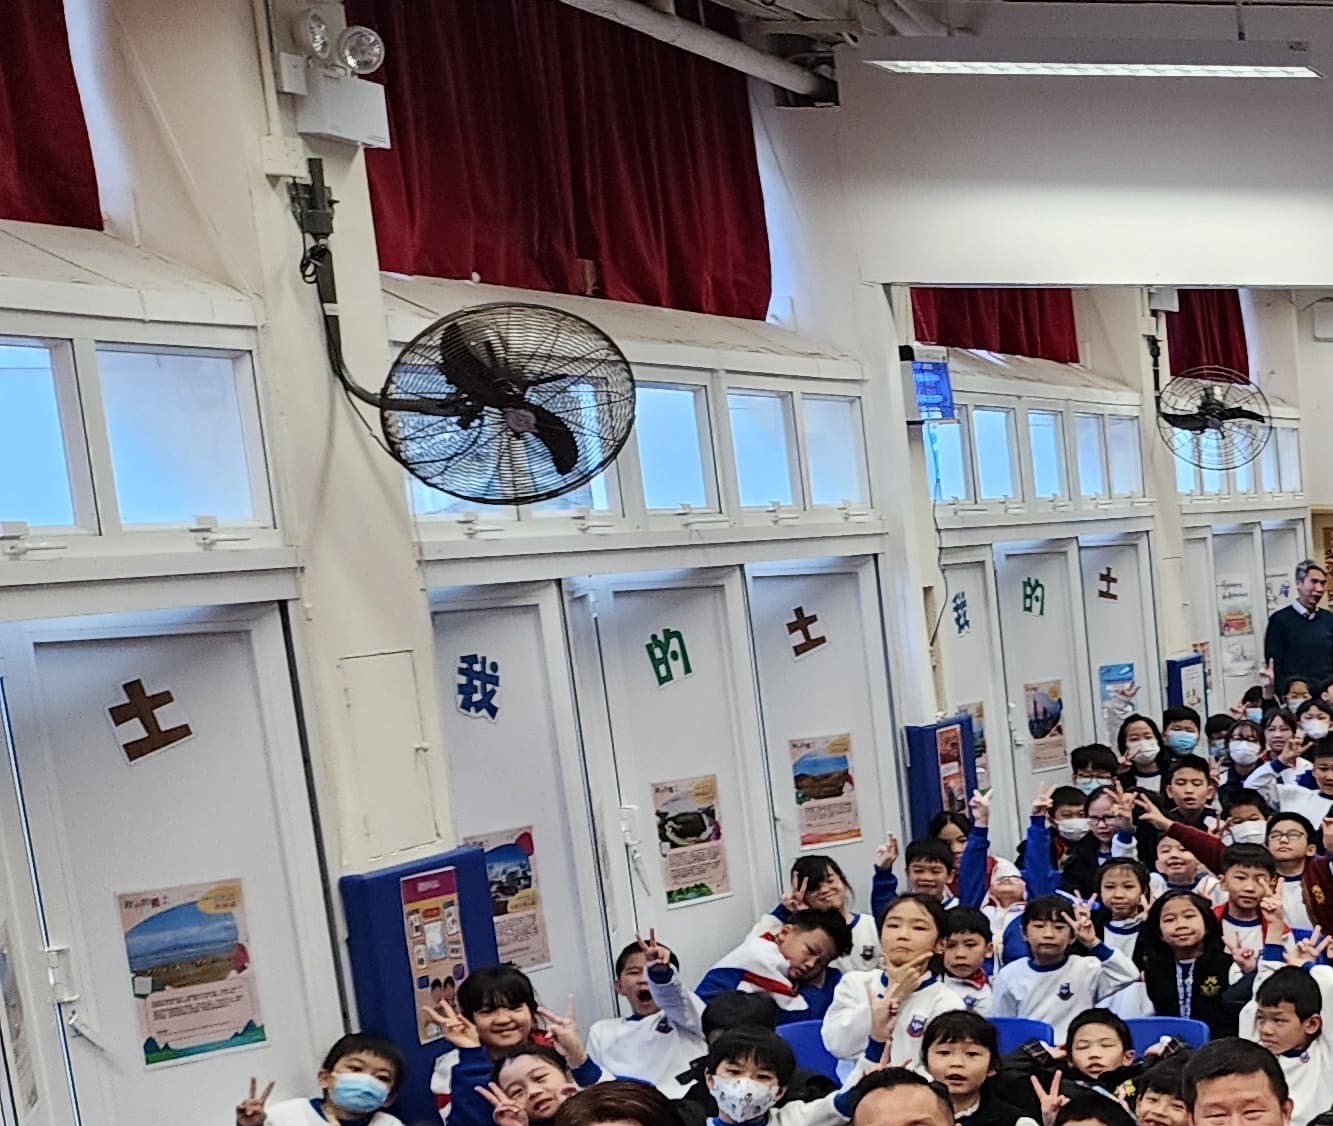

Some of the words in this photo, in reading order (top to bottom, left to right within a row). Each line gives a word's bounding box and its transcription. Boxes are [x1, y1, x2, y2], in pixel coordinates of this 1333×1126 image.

[1022, 577, 1045, 616] 的
[457, 653, 500, 720] 我
[645, 628, 692, 687] 的
